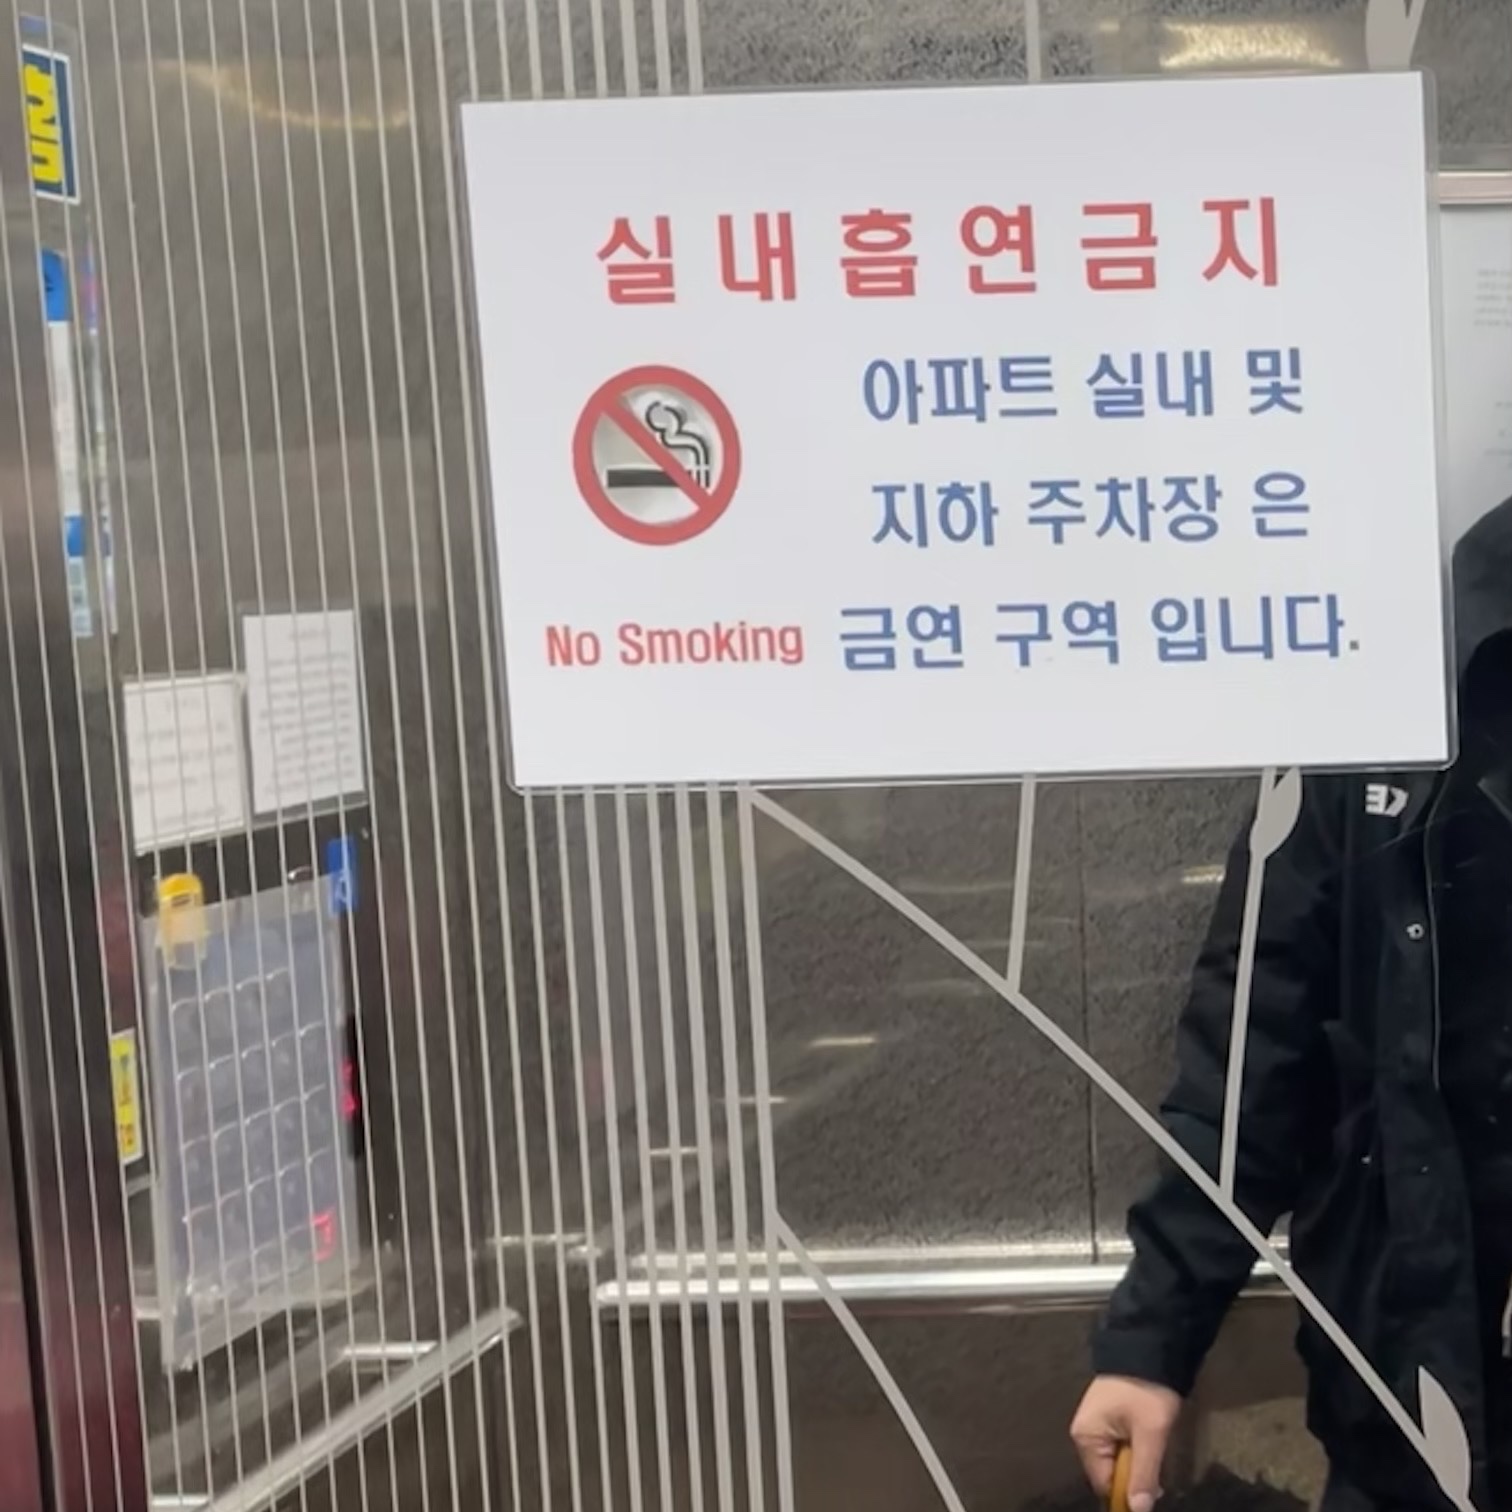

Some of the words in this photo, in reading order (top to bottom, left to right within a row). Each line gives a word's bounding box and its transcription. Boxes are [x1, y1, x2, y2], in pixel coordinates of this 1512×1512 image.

[862, 355, 1059, 426] 아파트
[1085, 349, 1215, 420] 실내
[1245, 346, 1304, 416] 및
[871, 480, 1000, 549] 지하
[1027, 473, 1224, 546] 주차장
[1251, 470, 1311, 539] 은
[545, 624, 602, 667] No
[617, 620, 805, 667] Smoking
[839, 603, 965, 672] 금연
[995, 599, 1120, 669] 구역
[1150, 592, 1360, 664] 입니다.
